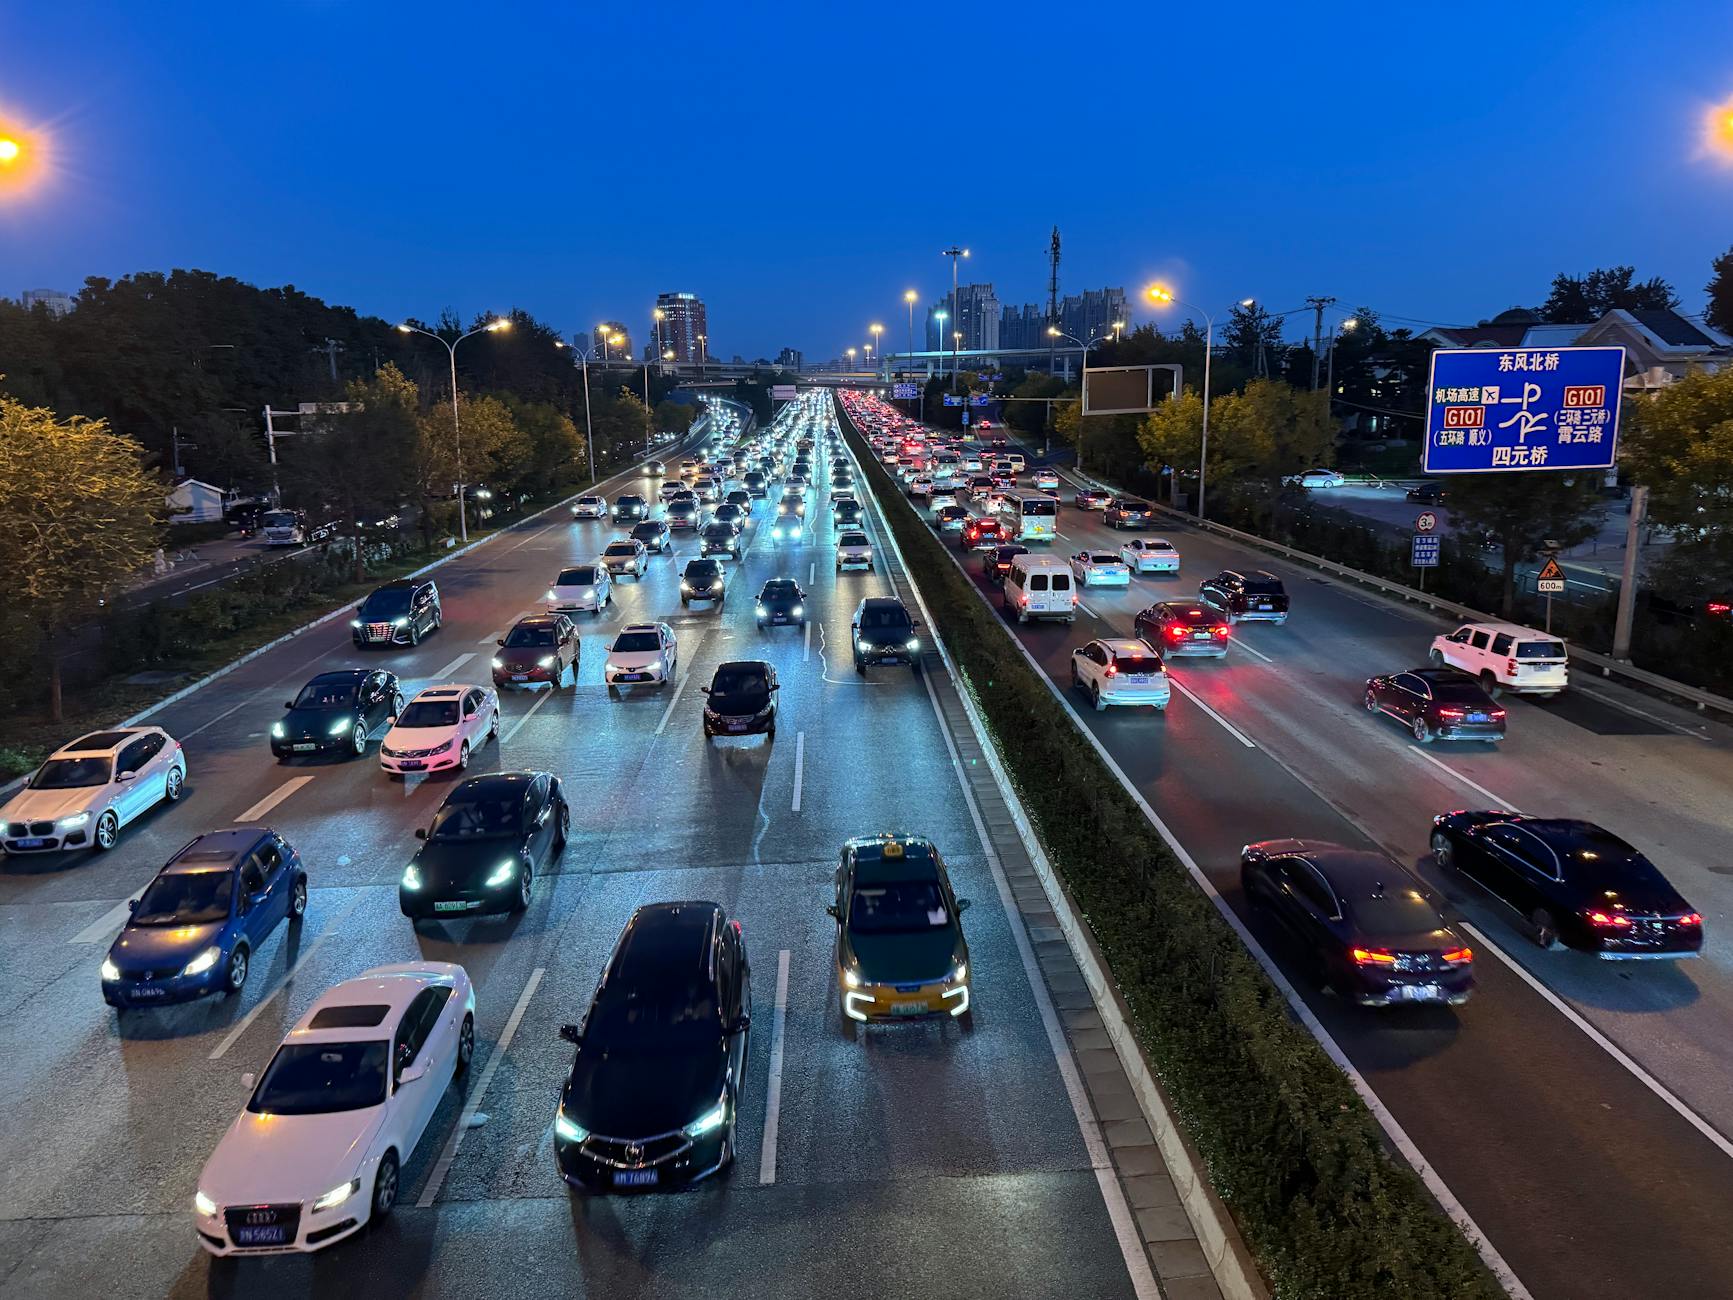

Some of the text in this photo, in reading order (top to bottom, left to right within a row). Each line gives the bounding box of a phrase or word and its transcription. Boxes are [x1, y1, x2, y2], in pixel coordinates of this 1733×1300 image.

[1498, 353, 1559, 371] 东风北桥
[1435, 387, 1480, 403] 机场高速
[1567, 389, 1602, 405] G101
[1447, 408, 1482, 425] G101
[1557, 426, 1603, 444] 霄云路
[1492, 446, 1548, 466] 四元桥
[1540, 582, 1562, 590] 600m
